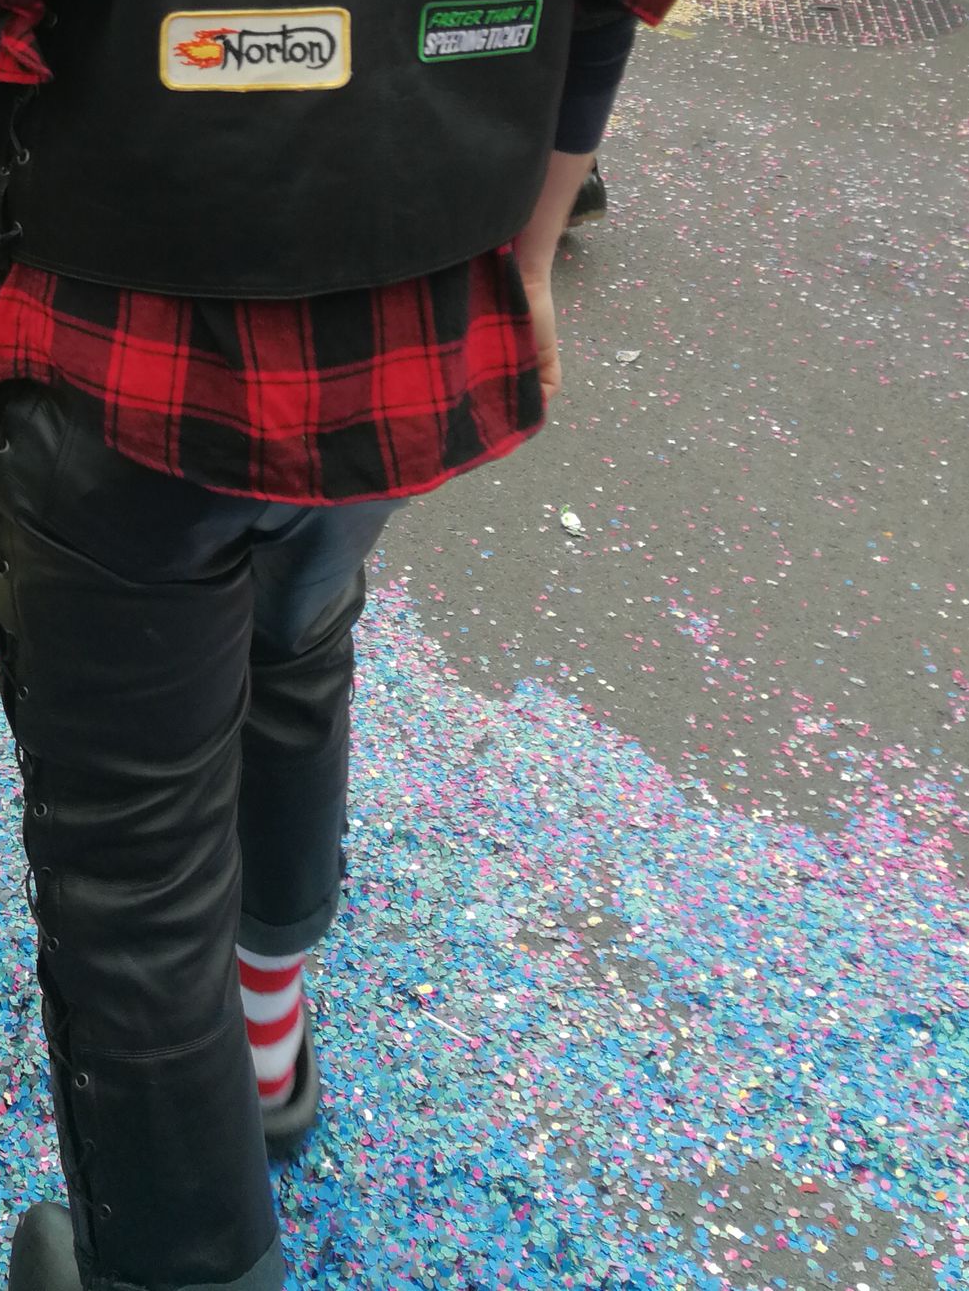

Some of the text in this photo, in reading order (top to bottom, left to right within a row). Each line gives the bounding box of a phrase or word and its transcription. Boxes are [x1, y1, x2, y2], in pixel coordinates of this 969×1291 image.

[427, 10, 484, 29] FASTER
[213, 23, 337, 72] Norton
[486, 23, 534, 51] TICKET
